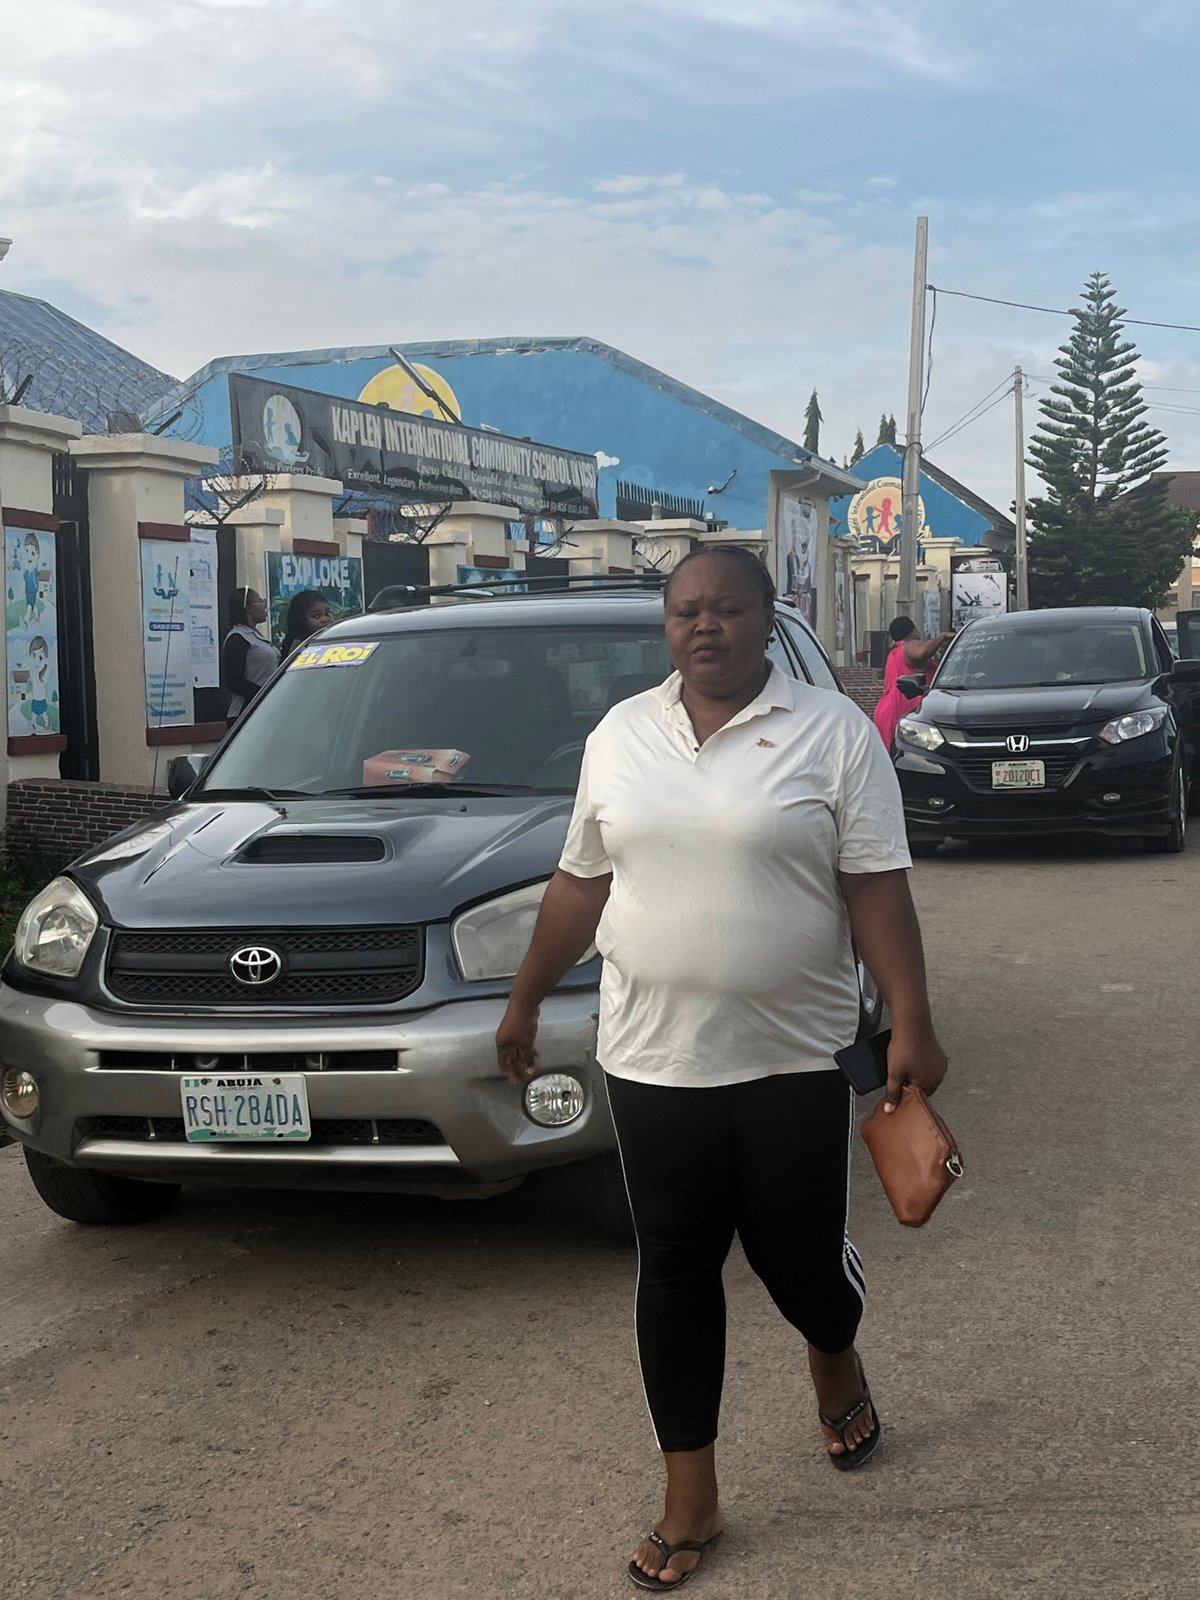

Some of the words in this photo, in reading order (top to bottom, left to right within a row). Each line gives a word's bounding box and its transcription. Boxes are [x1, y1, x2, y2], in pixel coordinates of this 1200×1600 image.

[332, 406, 382, 449] KAPLEN
[384, 418, 470, 465] INTERNATIONAL
[472, 436, 531, 477] COMMUNITY
[532, 450, 571, 485] SCHOOL
[282, 555, 351, 589] EXPLORE
[217, 1079, 263, 1087] ABUJA
